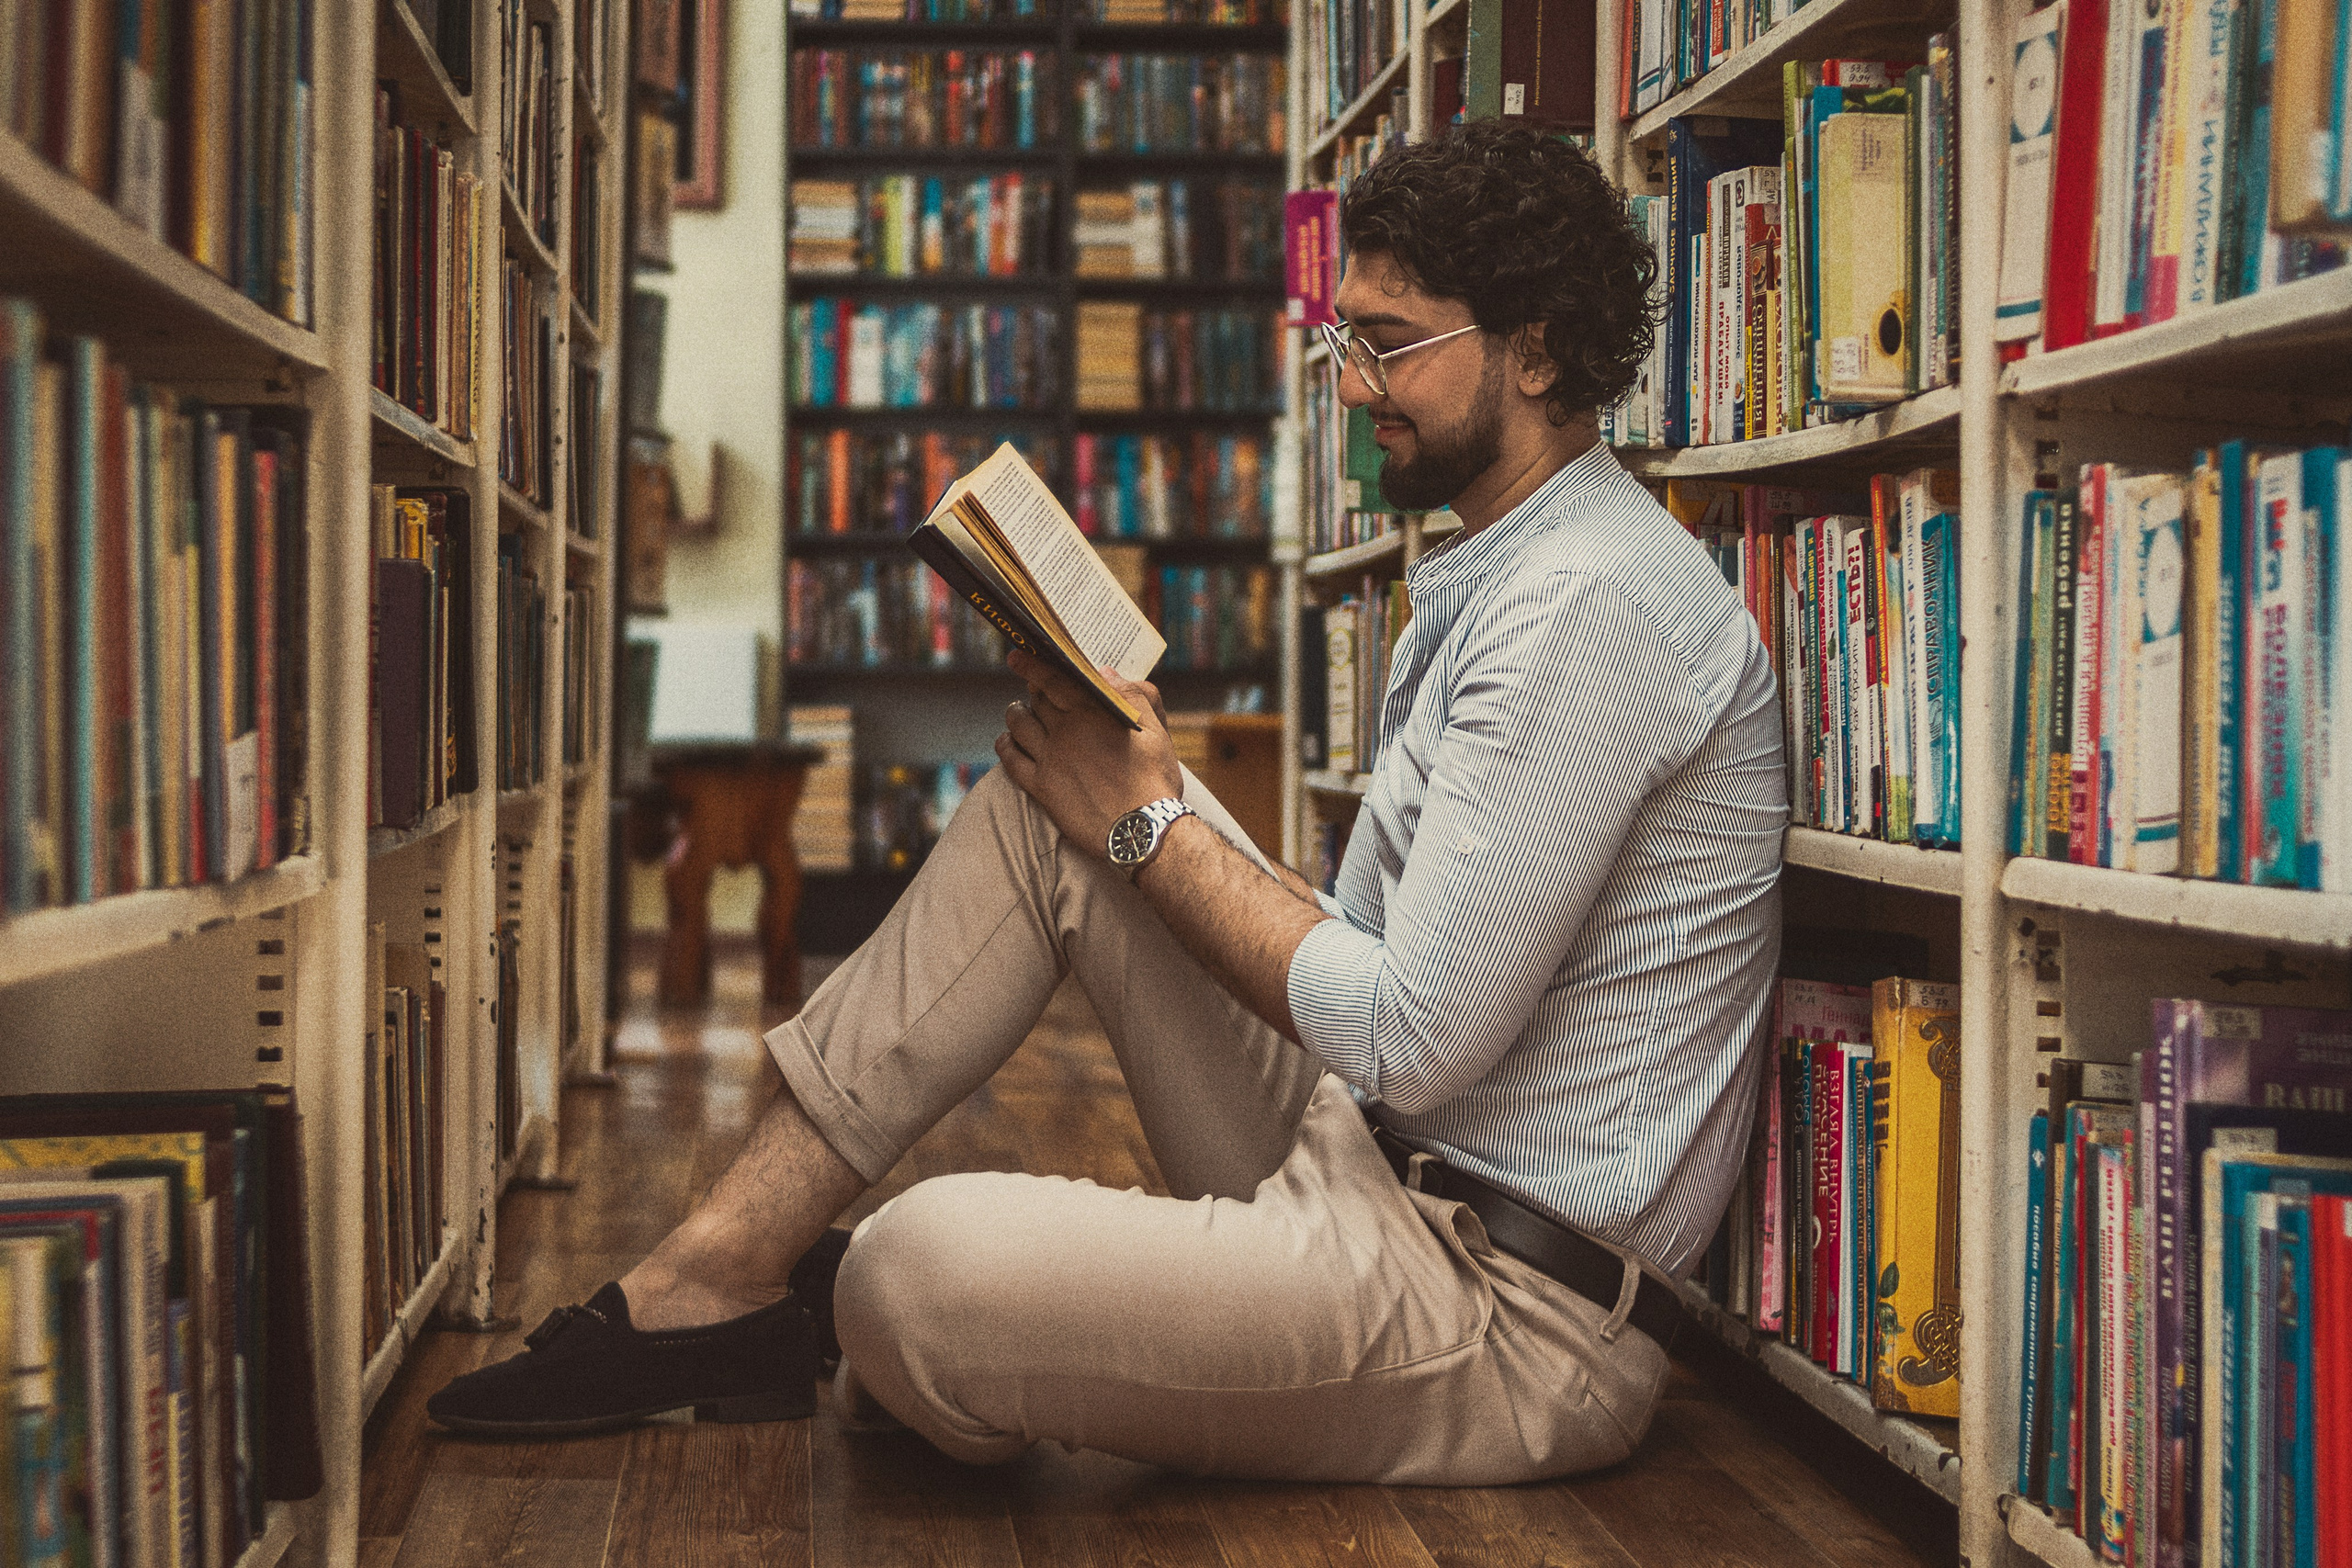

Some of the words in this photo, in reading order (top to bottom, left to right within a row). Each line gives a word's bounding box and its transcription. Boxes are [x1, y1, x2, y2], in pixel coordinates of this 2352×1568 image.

[1717, 300, 1725, 406] ПРАБАБУШКИ!
[1756, 303, 1764, 423] ОЧИЩЕНИЯ
[1807, 536, 1815, 547] И.
[1807, 549, 1815, 603] БОРЩЕНКО
[1848, 544, 1861, 625] ЕСТЬ?!
[2056, 502, 2073, 610] ребенка
[1809, 604, 1817, 691] ИЗОМЕТРИЧЕСКАЯ
[1921, 536, 1939, 694] СПРАВОЧНИК
[1829, 1068, 1841, 1152] ВЗГЛЯД
[2159, 1035, 2174, 1198] РЕБЕНОК
[1829, 1158, 1839, 1244] ВНУТРЬ
[2031, 1204, 2041, 1269] пособие
[2160, 1213, 2174, 1301] ВАШ
[2028, 1276, 2038, 1382] современной
[2023, 1386, 2034, 1479] супермамы
